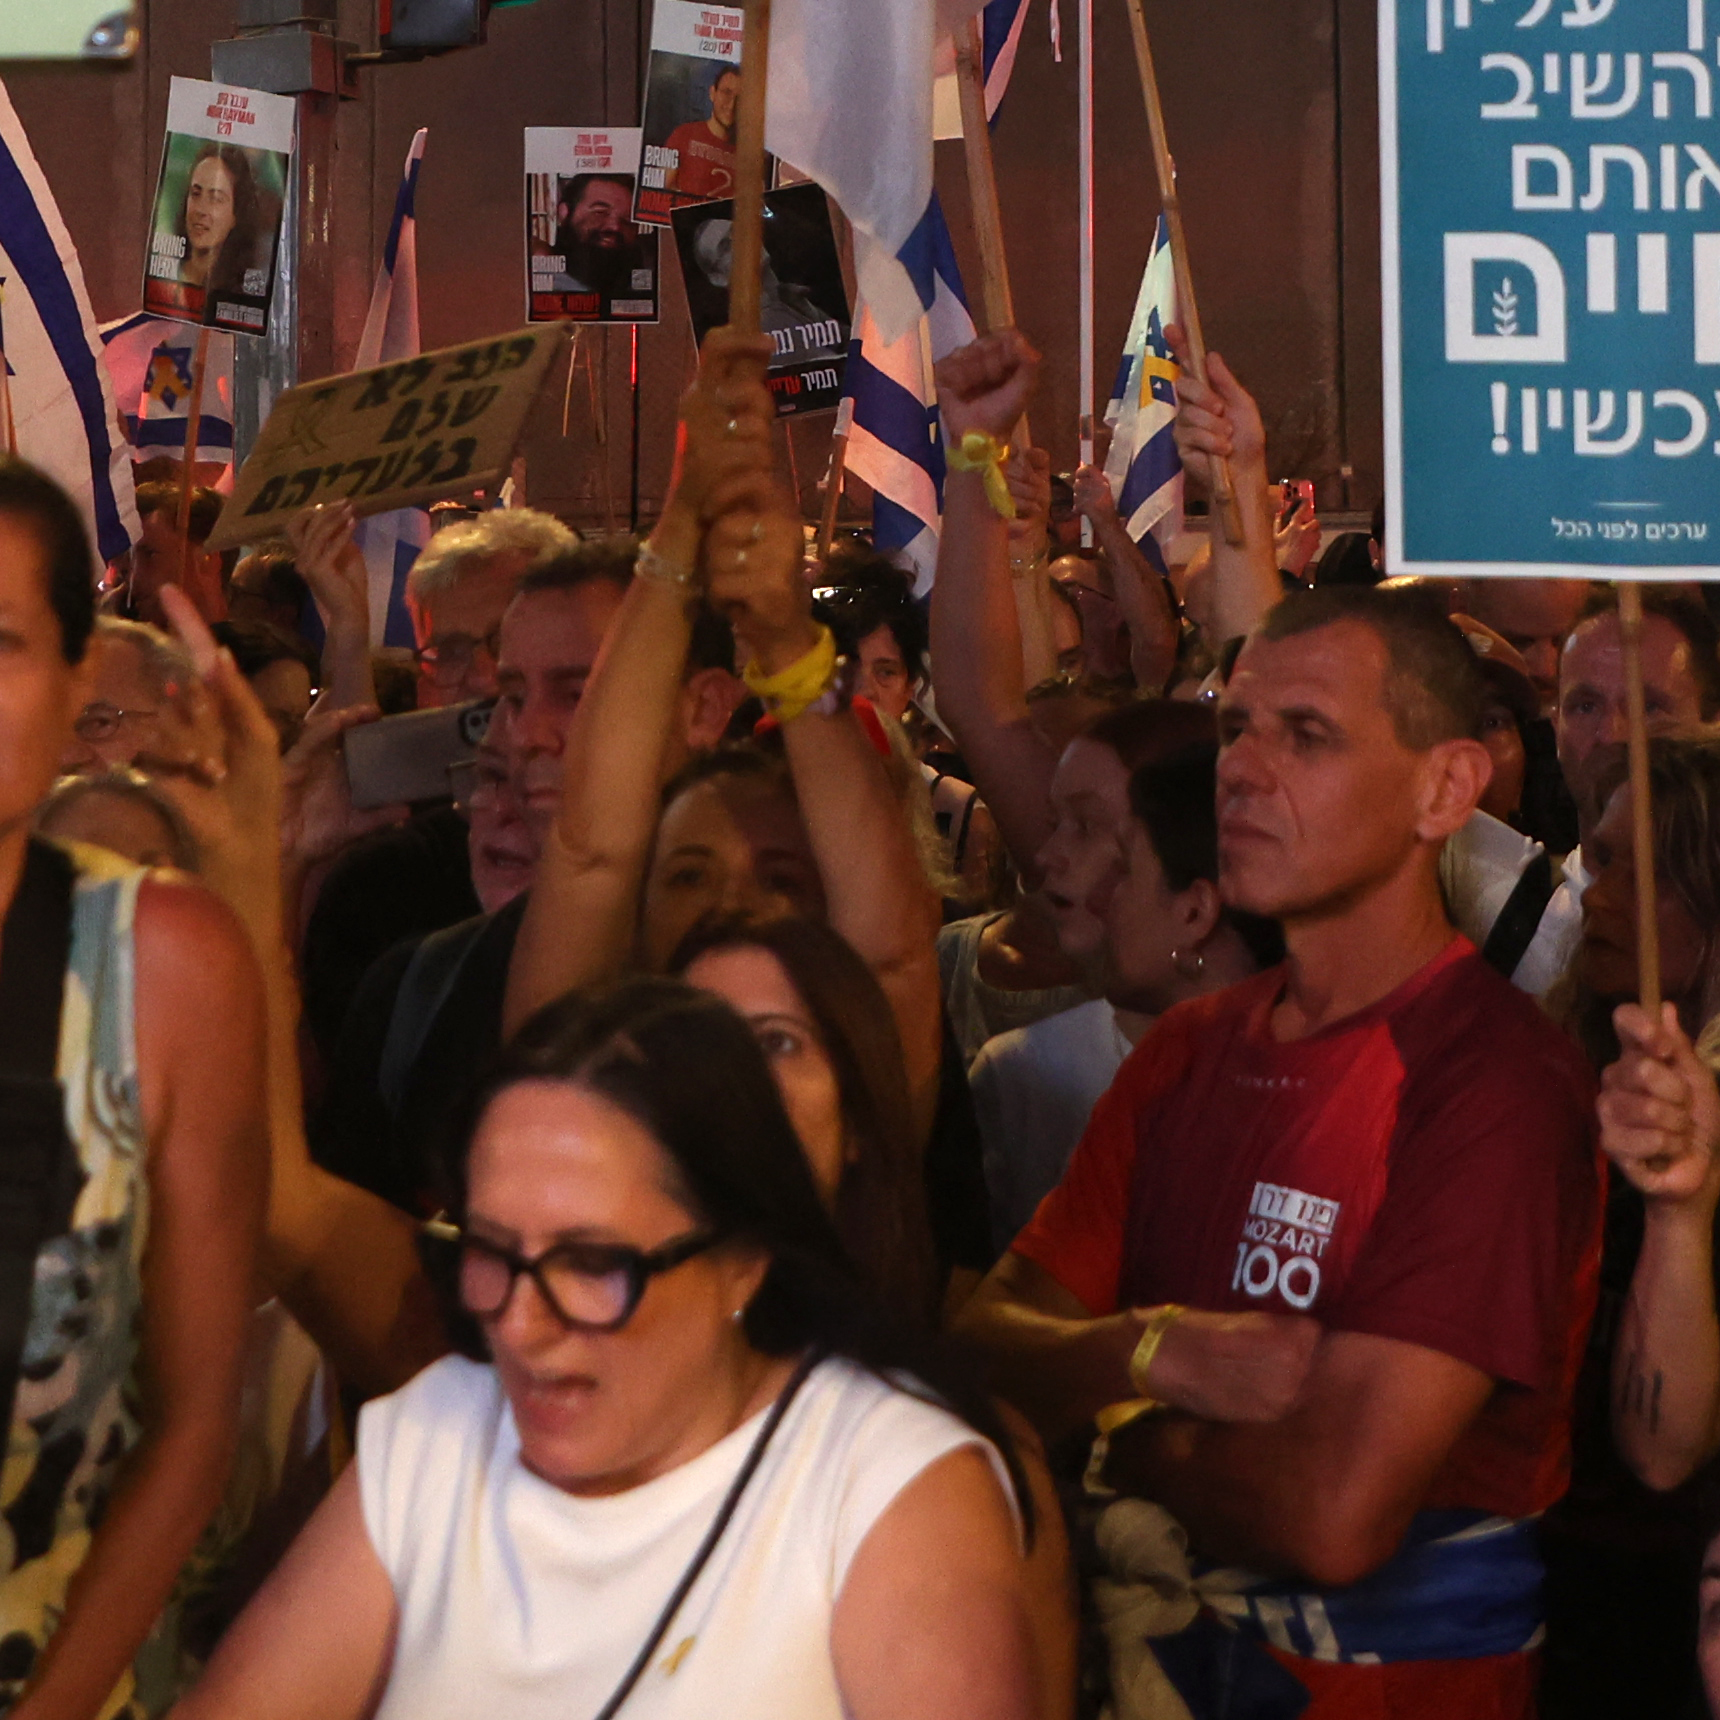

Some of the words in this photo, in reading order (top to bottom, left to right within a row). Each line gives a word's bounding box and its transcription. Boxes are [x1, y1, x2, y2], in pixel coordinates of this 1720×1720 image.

[644, 144, 680, 169] BRING
[641, 166, 666, 188] HIM
[151, 231, 187, 259] BRING
[532, 255, 566, 273] BRING
[795, 320, 842, 350] תמיר
[800, 368, 839, 391] תמיר
[1551, 516, 1593, 537] הכל
[1597, 519, 1639, 540] לפני
[1645, 521, 1708, 540] ערכים
[1245, 1218, 1331, 1258] MOZART
[1232, 1242, 1321, 1310] 100
